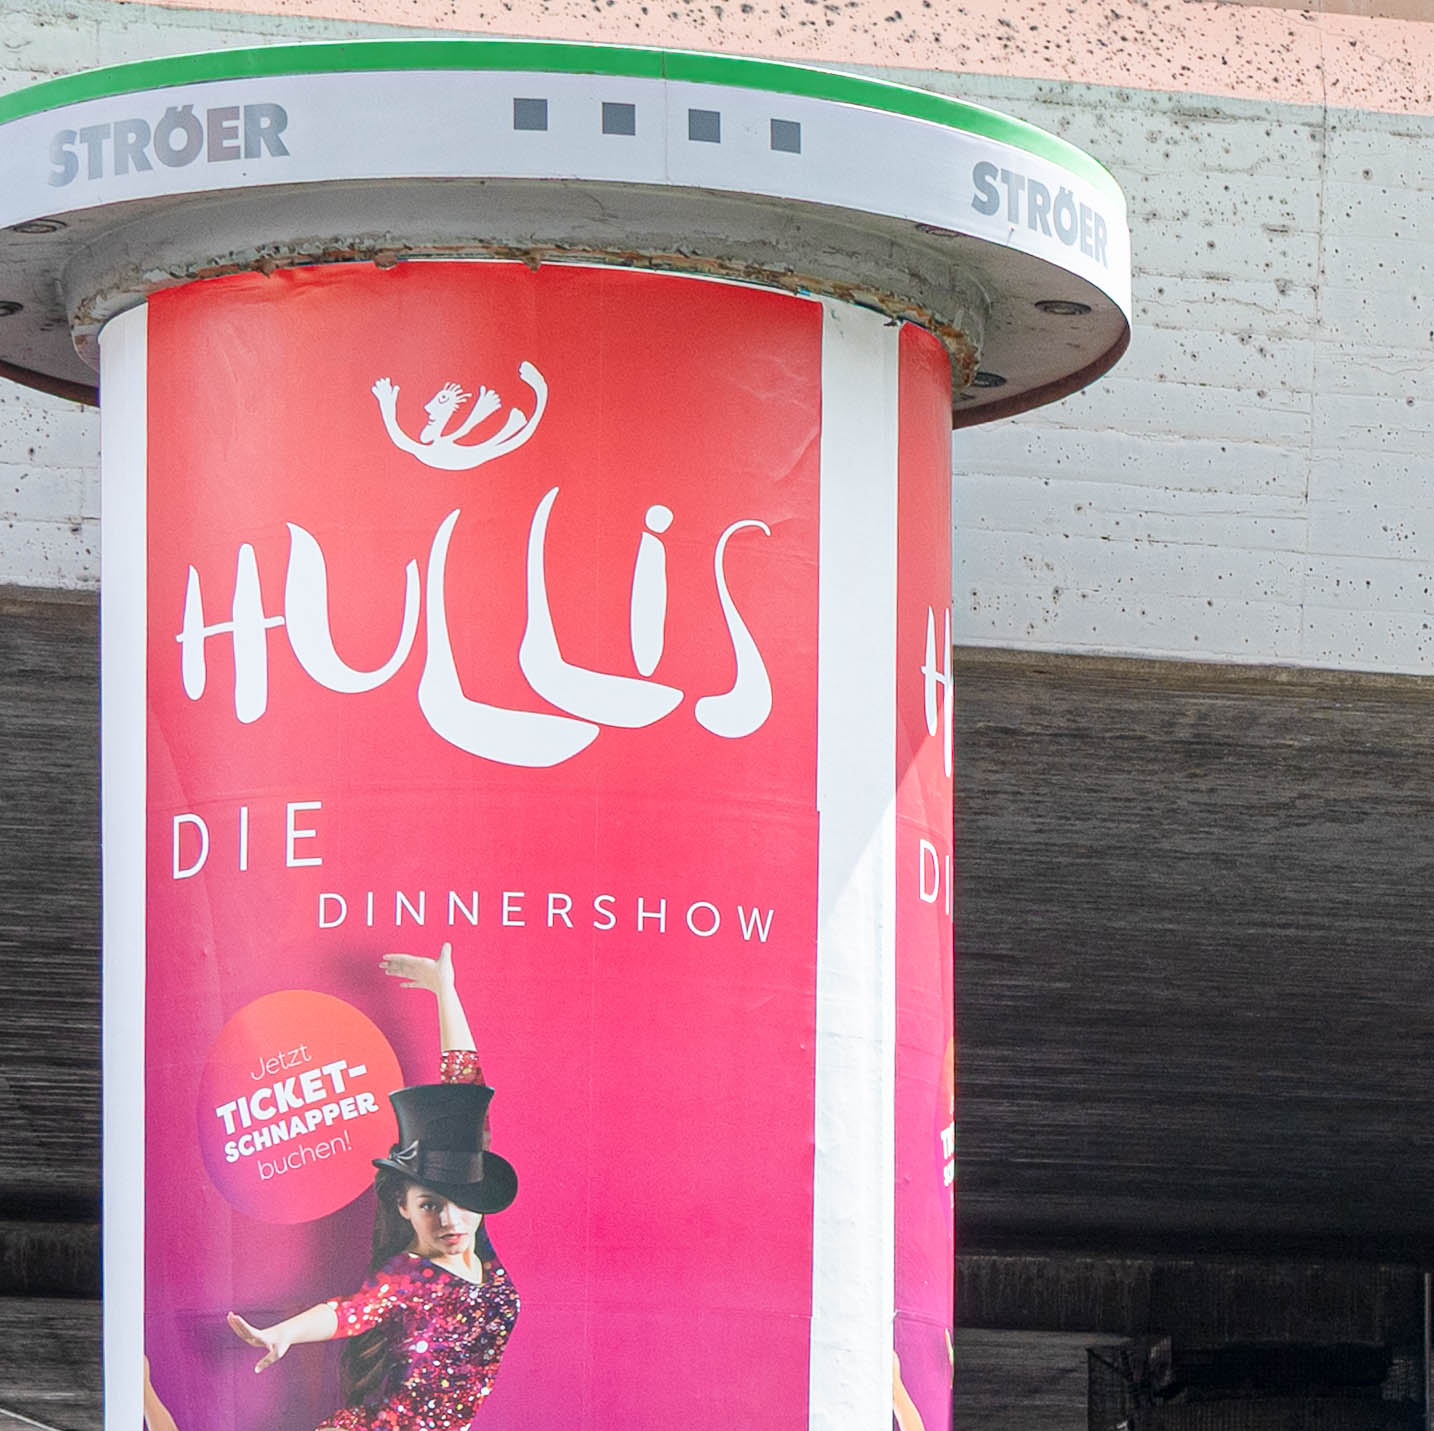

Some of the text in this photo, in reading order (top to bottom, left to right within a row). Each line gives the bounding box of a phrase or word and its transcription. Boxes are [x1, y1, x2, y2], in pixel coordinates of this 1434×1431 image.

[48, 100, 291, 188] STRÖER
[970, 160, 1110, 268] STRÖER
[171, 801, 323, 880] DIE
[317, 890, 777, 944] DINNERSHOW
[215, 1059, 368, 1136] TICKET-
[251, 1043, 312, 1081] Jetzt
[223, 1091, 380, 1164] SCHNAPPER
[256, 1129, 353, 1181] buchen!
